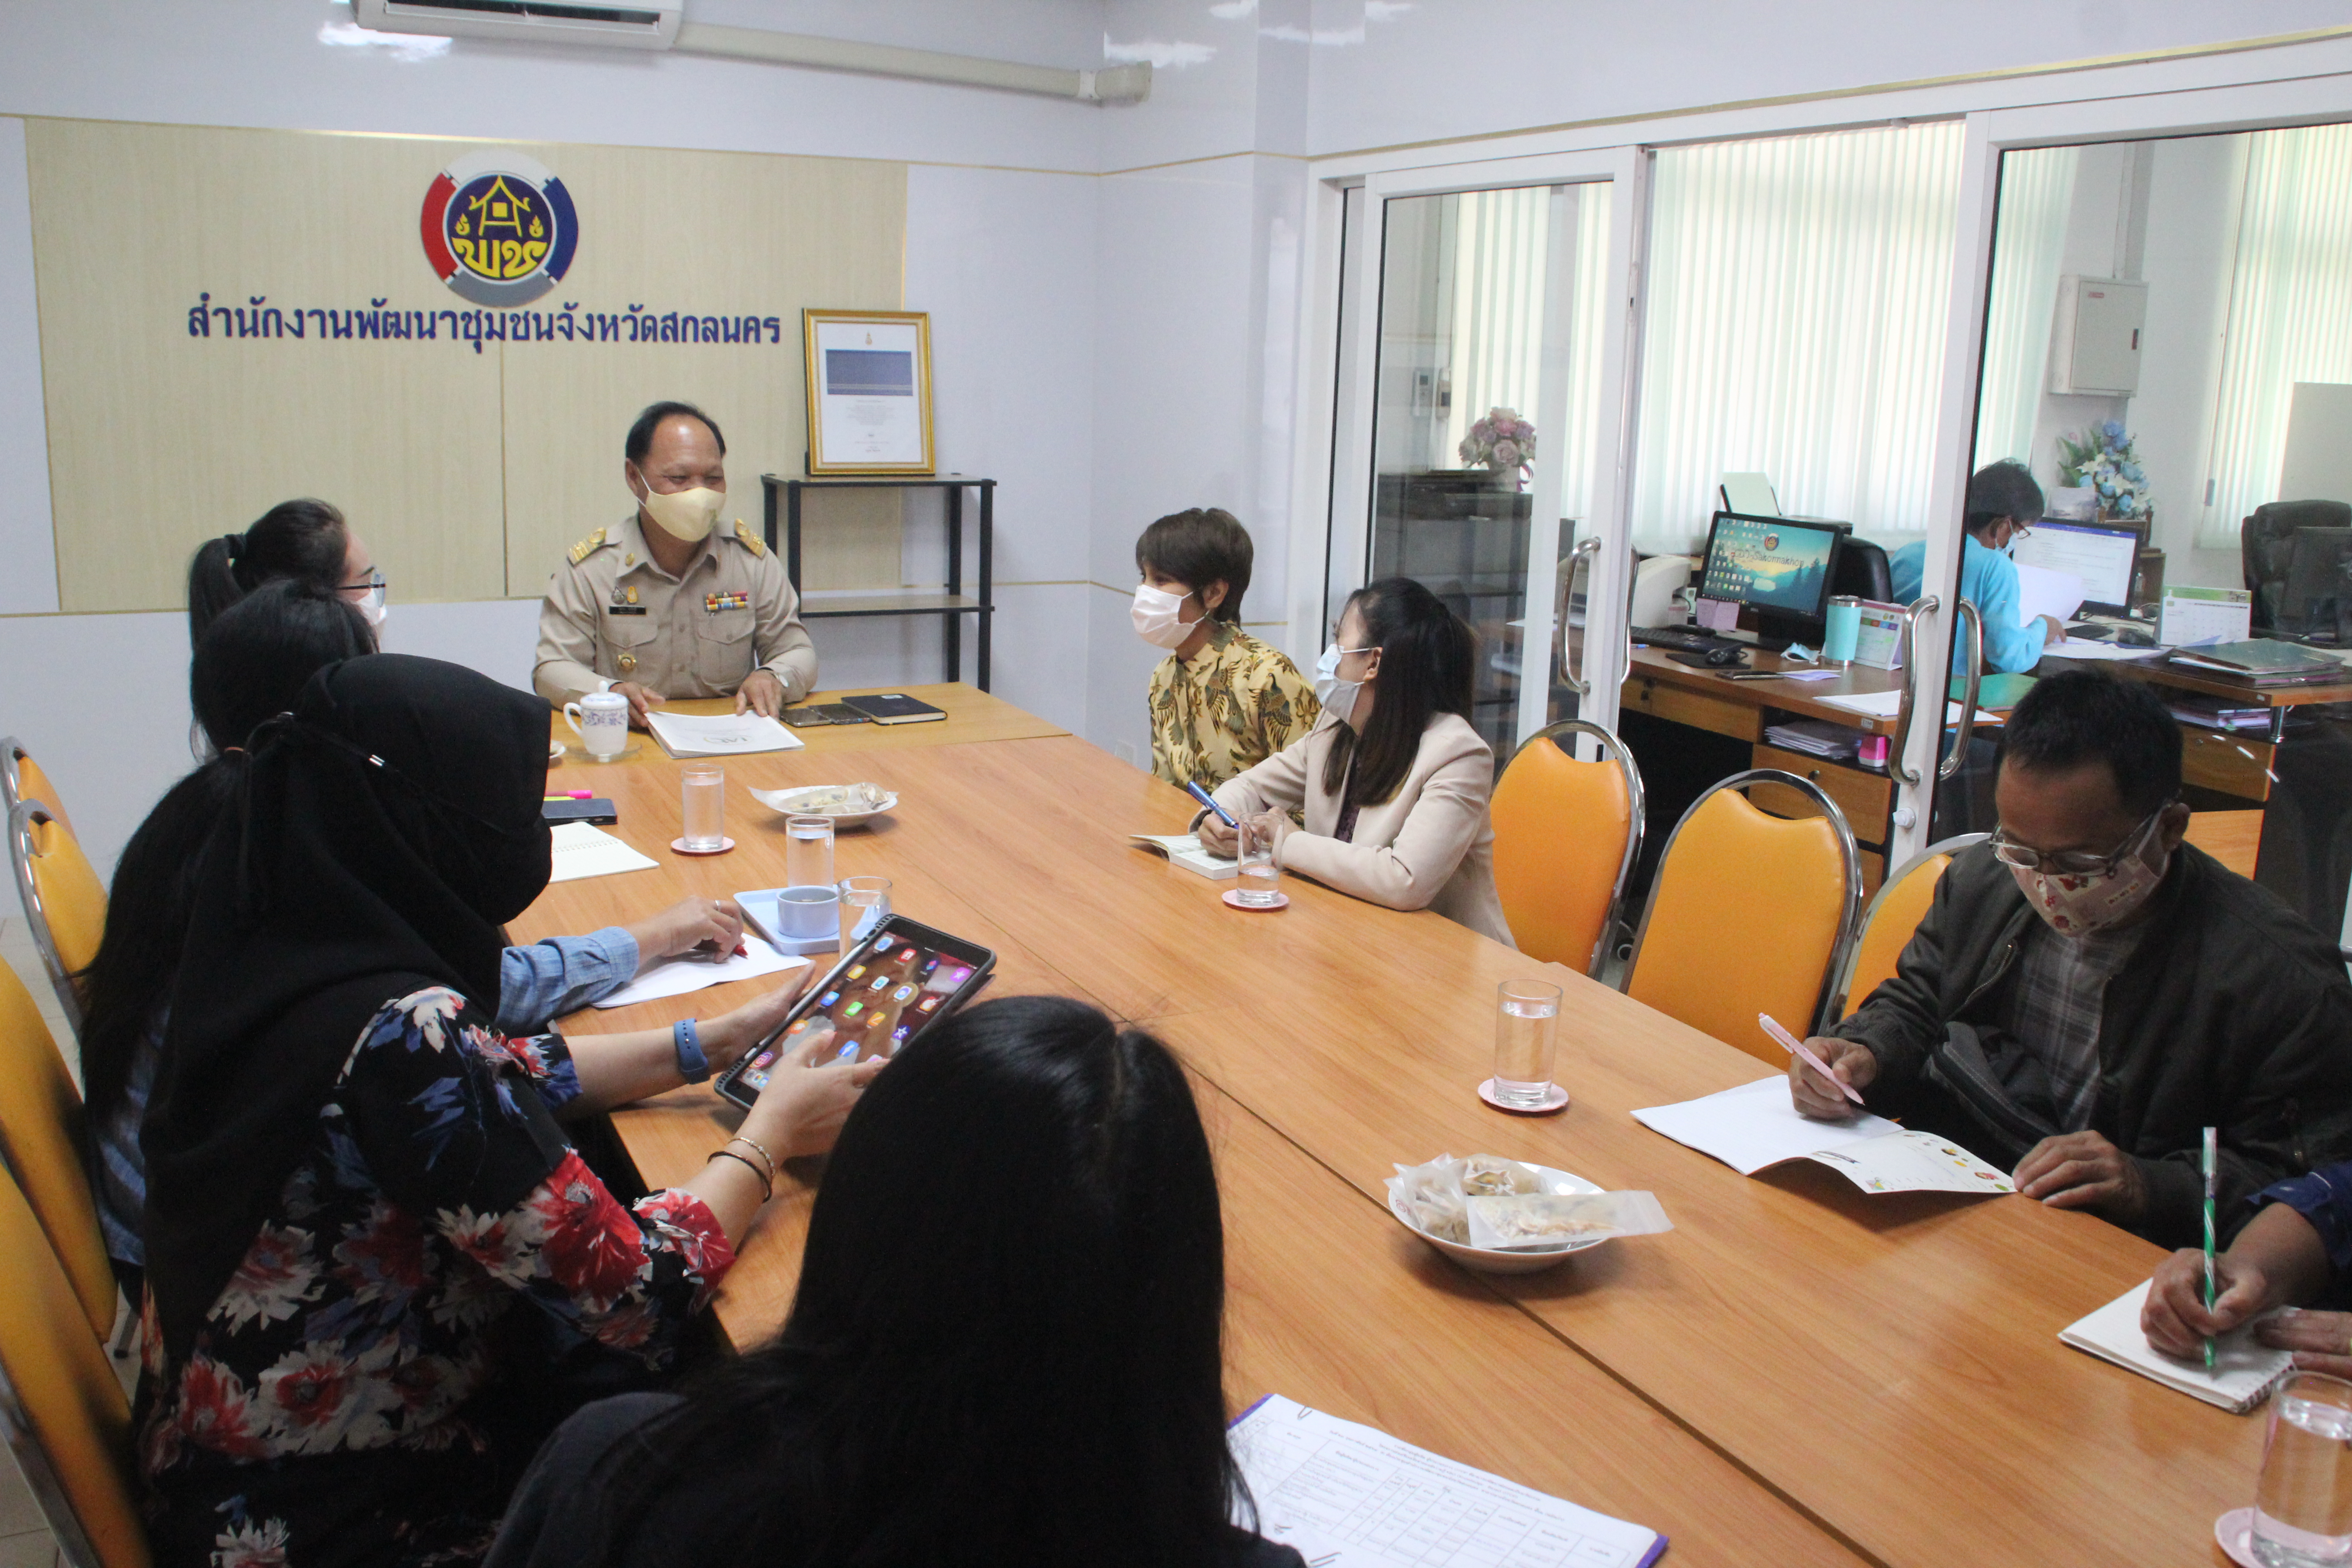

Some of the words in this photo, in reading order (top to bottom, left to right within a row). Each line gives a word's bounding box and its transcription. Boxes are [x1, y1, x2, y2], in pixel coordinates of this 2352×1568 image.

[188, 292, 780, 354] สำนักงานพัฒนาชุมชนจังหวัดสกลนคร
